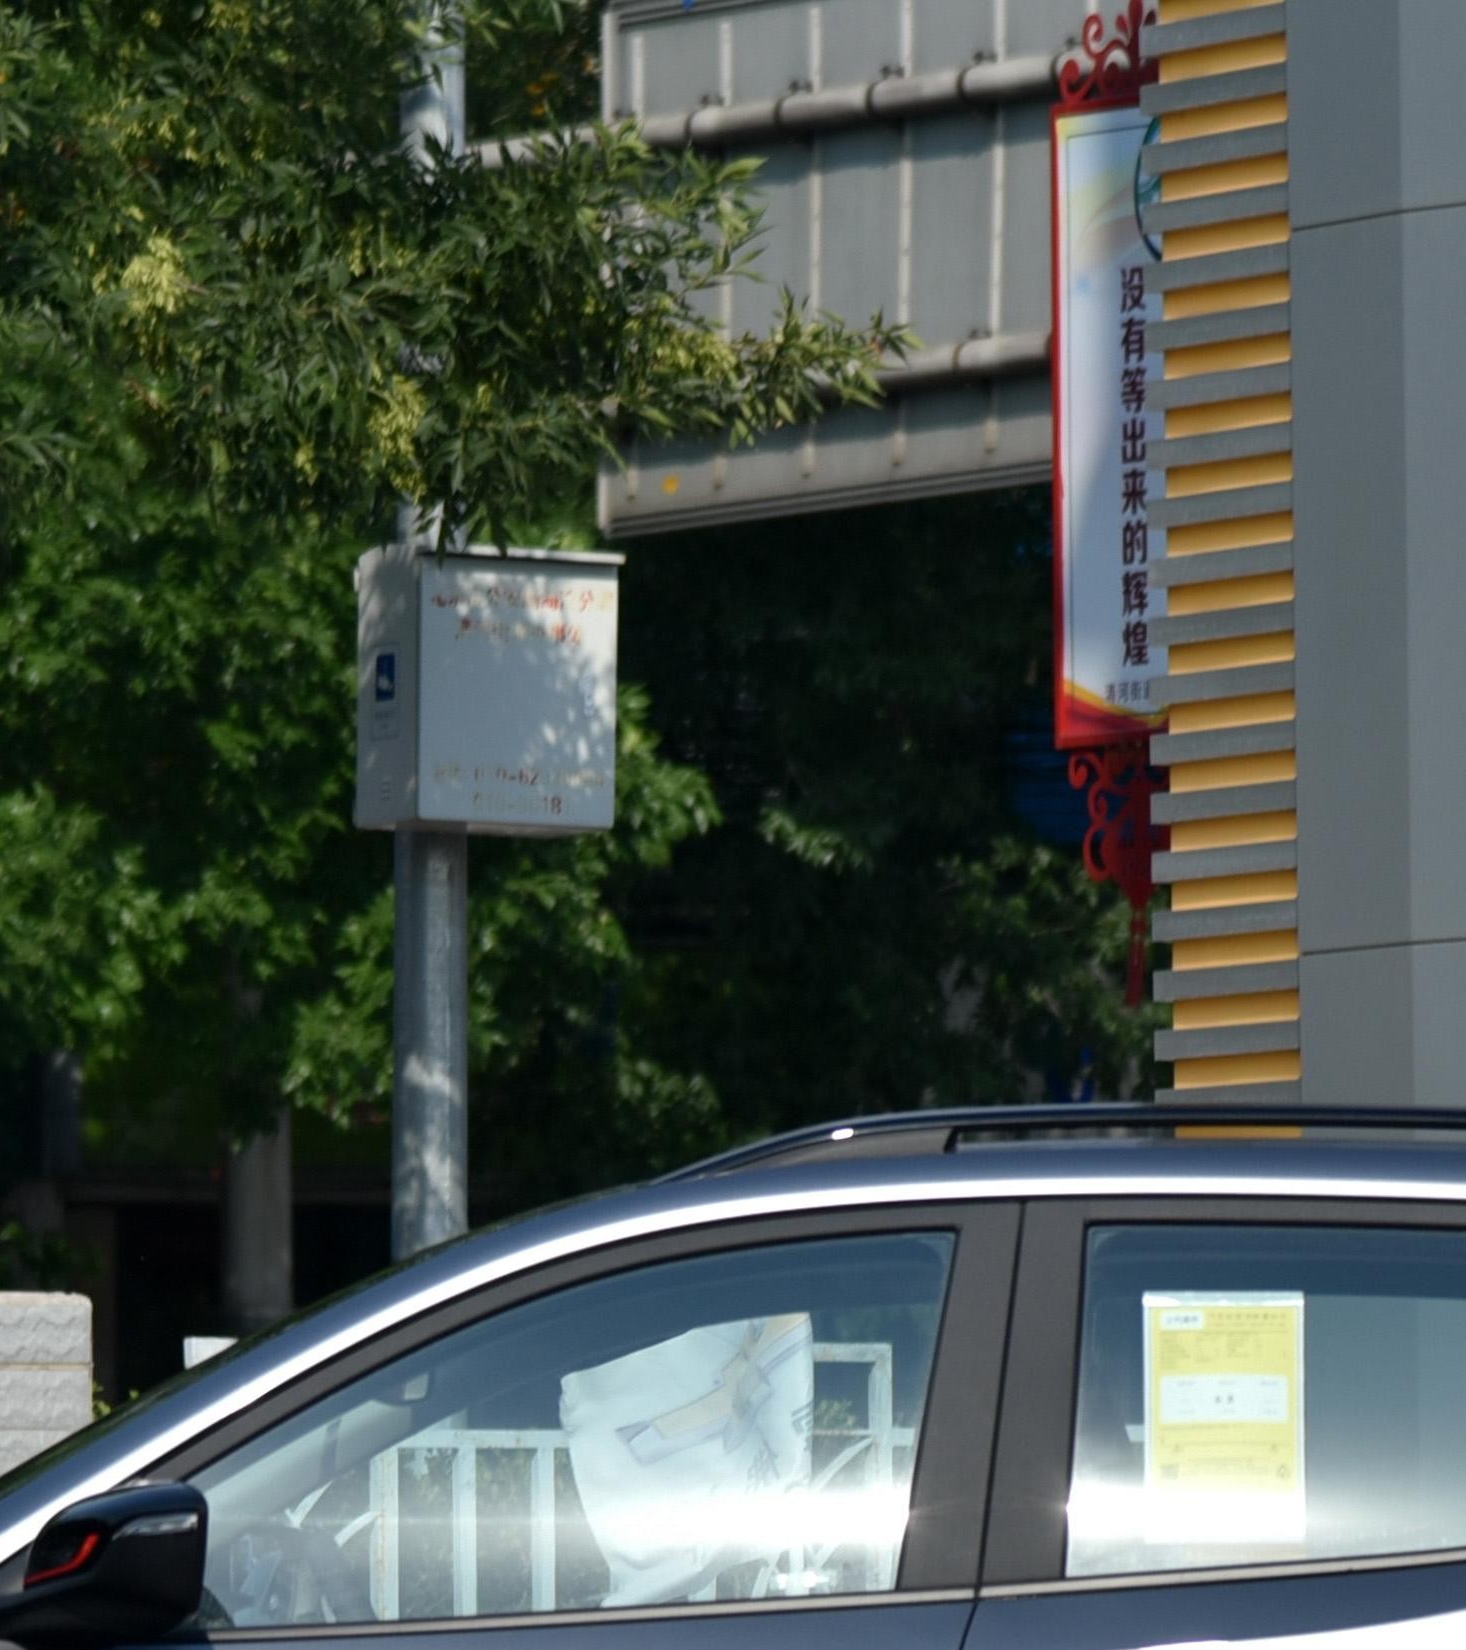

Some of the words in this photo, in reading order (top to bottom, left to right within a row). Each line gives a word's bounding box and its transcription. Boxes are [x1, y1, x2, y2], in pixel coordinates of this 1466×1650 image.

[1121, 267, 1149, 667] 没有等出来的辉煌
